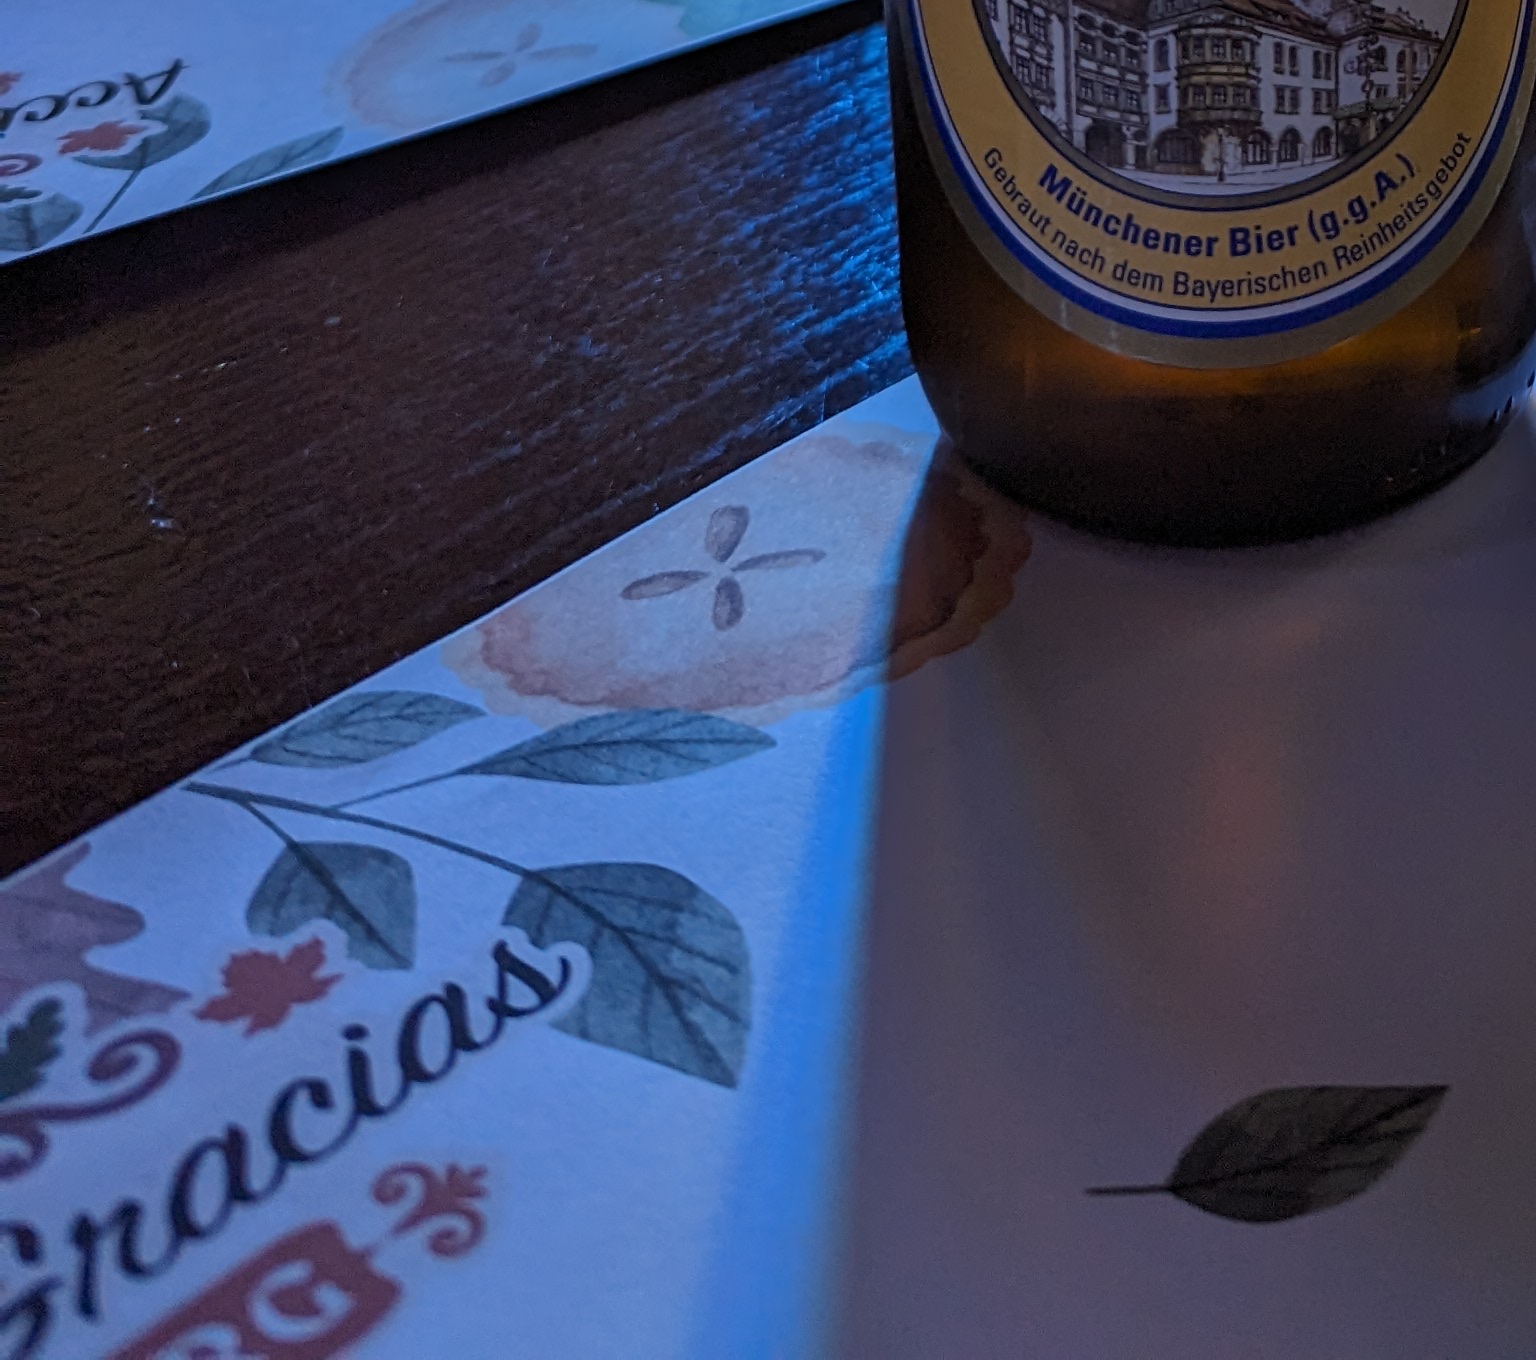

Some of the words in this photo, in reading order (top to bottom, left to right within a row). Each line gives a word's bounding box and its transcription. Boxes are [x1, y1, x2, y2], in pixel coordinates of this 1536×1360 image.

[983, 147, 1052, 235] Gebraut
[1051, 229, 1106, 274] nach
[1112, 260, 1164, 292] dem
[1172, 261, 1328, 304] Bayerischen
[1333, 131, 1472, 271] Reinheitsgebot
[1038, 163, 1220, 257] Münchener
[1228, 224, 1299, 258] Bier
[1307, 153, 1416, 243] (g.g.A.)
